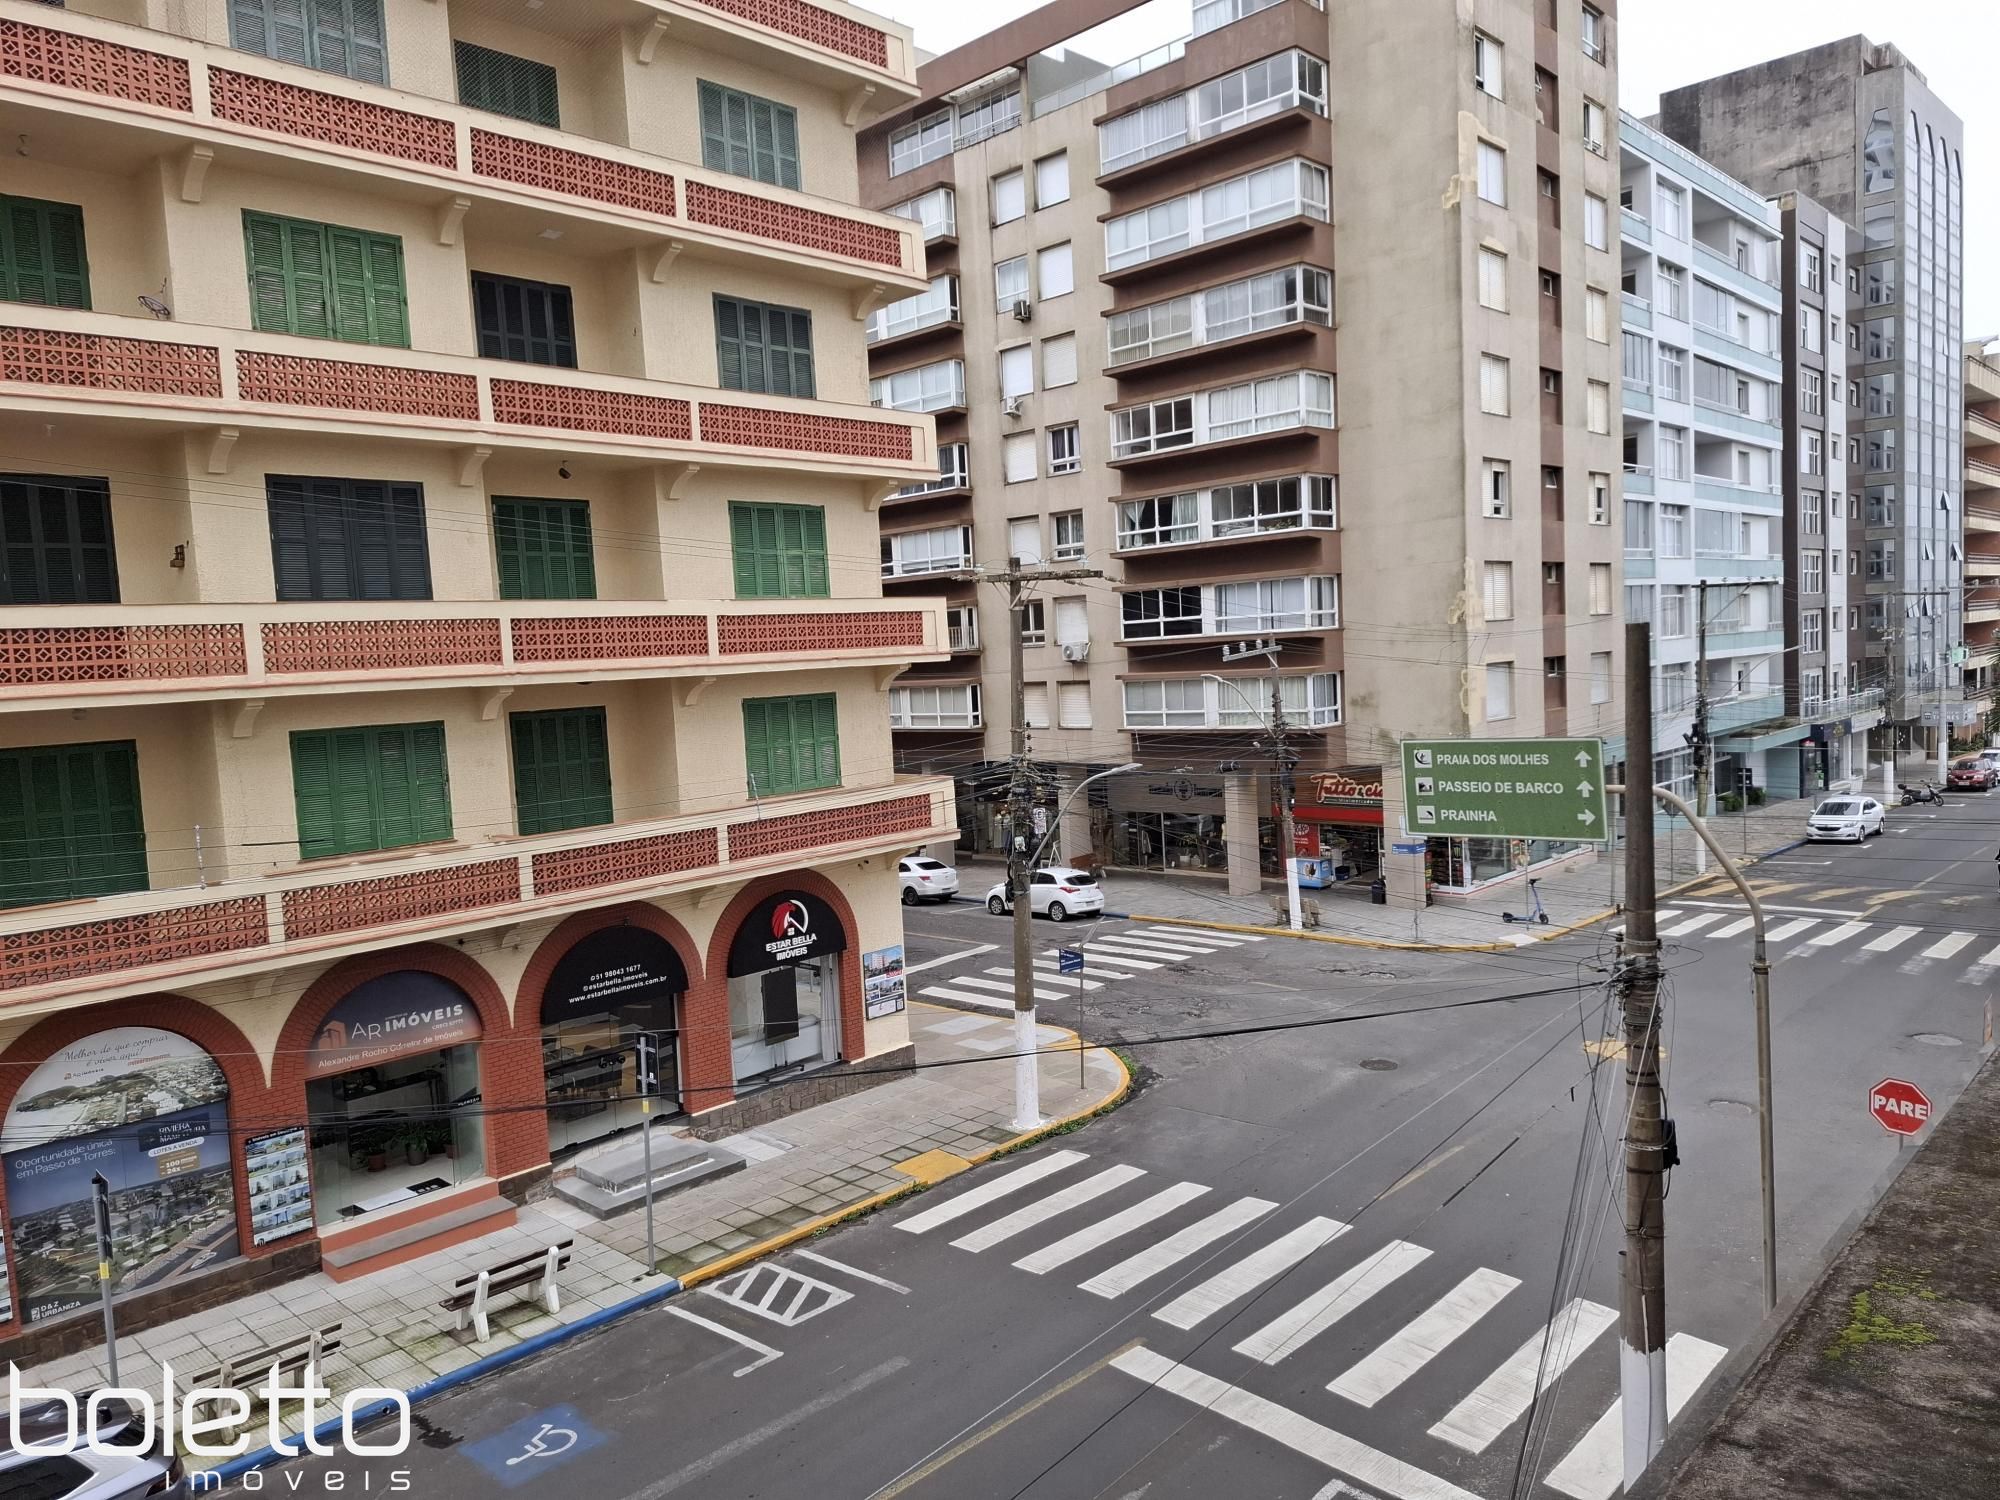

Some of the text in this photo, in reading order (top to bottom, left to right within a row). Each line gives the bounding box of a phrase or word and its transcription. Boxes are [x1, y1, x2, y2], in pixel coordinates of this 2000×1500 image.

[1436, 753, 1550, 766] PRAIA DOS MOLHES
[1437, 780, 1564, 795] PASSEIO DE BARCO
[1440, 809, 1497, 822] PRAINHA
[765, 932, 817, 952] ESTAR BELLA
[776, 946, 808, 961] IMÓVEIS
[604, 968, 625, 978] 98043
[568, 975, 668, 1004] www.estarbellaimoveis.com.br
[351, 1004, 464, 1040] AR IMÓVEIS
[317, 1053, 361, 1069] Alexandre
[422, 1034, 433, 1044] de
[1873, 1094, 1929, 1121] PARE
[15, 1137, 113, 1170] Oportunidade única
[16, 1168, 34, 1179] em
[35, 1160, 66, 1174] Passo
[66, 1156, 81, 1167] de
[41, 1300, 81, 1318] URBANIZA
